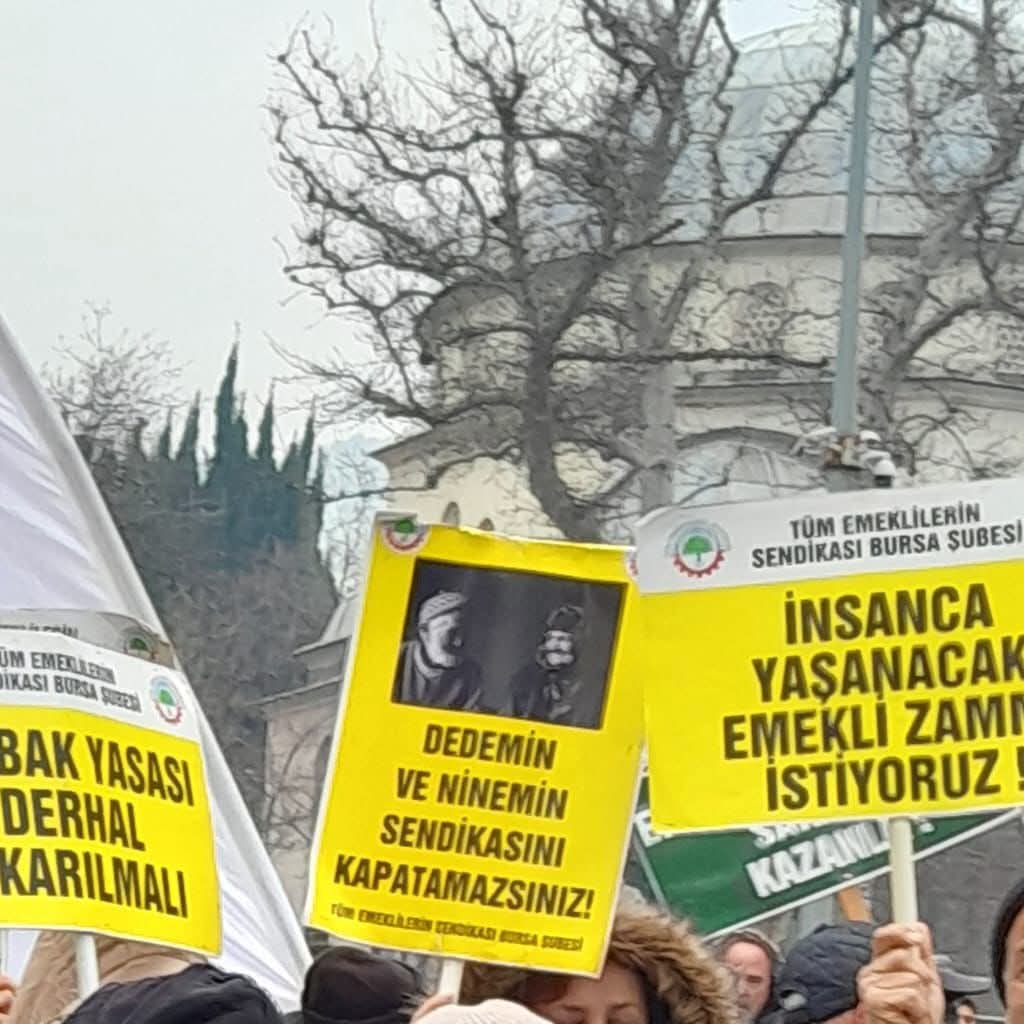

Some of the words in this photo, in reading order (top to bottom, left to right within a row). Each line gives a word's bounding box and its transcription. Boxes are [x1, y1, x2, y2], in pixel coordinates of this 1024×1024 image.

[751, 539, 863, 569] SENDİKASI
[870, 533, 940, 558] BURSA
[947, 523, 1023, 552] ŞUBESİ
[790, 515, 834, 539] TÜM
[843, 500, 981, 534] EMEKLİLERİN
[784, 583, 994, 645] İNSANCA
[54, 675, 98, 701] BURSA
[752, 635, 1024, 705] YAŞANACAK
[423, 722, 558, 770] DEDEMİN
[723, 694, 889, 760] EMEKLİ
[85, 735, 195, 807] YASASI
[396, 766, 431, 802] VE
[436, 768, 569, 821] NİNEMİN
[766, 748, 1001, 812] İSTİYORUZ
[0, 787, 146, 852] DERHAL
[380, 814, 567, 868] SENDİKASINI
[333, 853, 596, 920] KAPATAMAZSINIZ!
